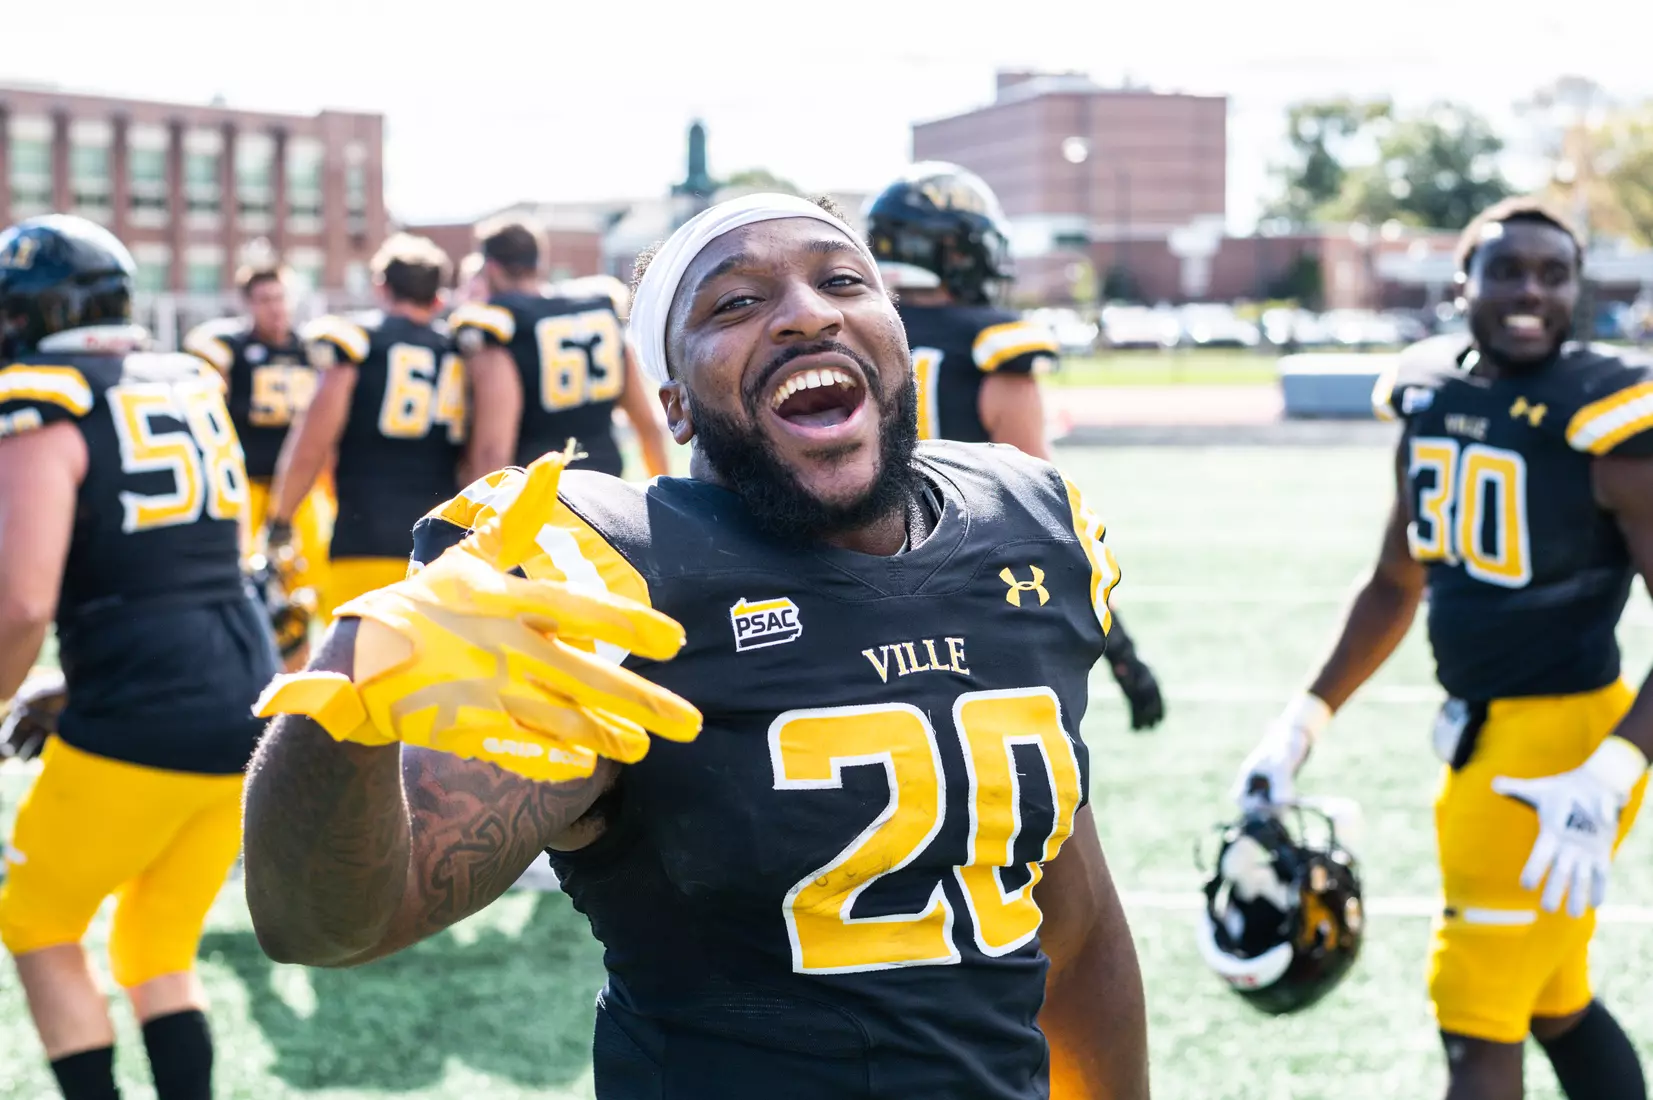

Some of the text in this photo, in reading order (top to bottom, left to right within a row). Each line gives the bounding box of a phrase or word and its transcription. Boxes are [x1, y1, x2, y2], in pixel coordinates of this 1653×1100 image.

[379, 343, 467, 443] 64
[535, 309, 624, 412] 63
[107, 380, 249, 533] 58
[1408, 437, 1532, 587] 30
[735, 608, 796, 637] PSAC
[861, 637, 970, 683] VILLE
[482, 737, 545, 759] GRIP
[767, 686, 1082, 975] 20
